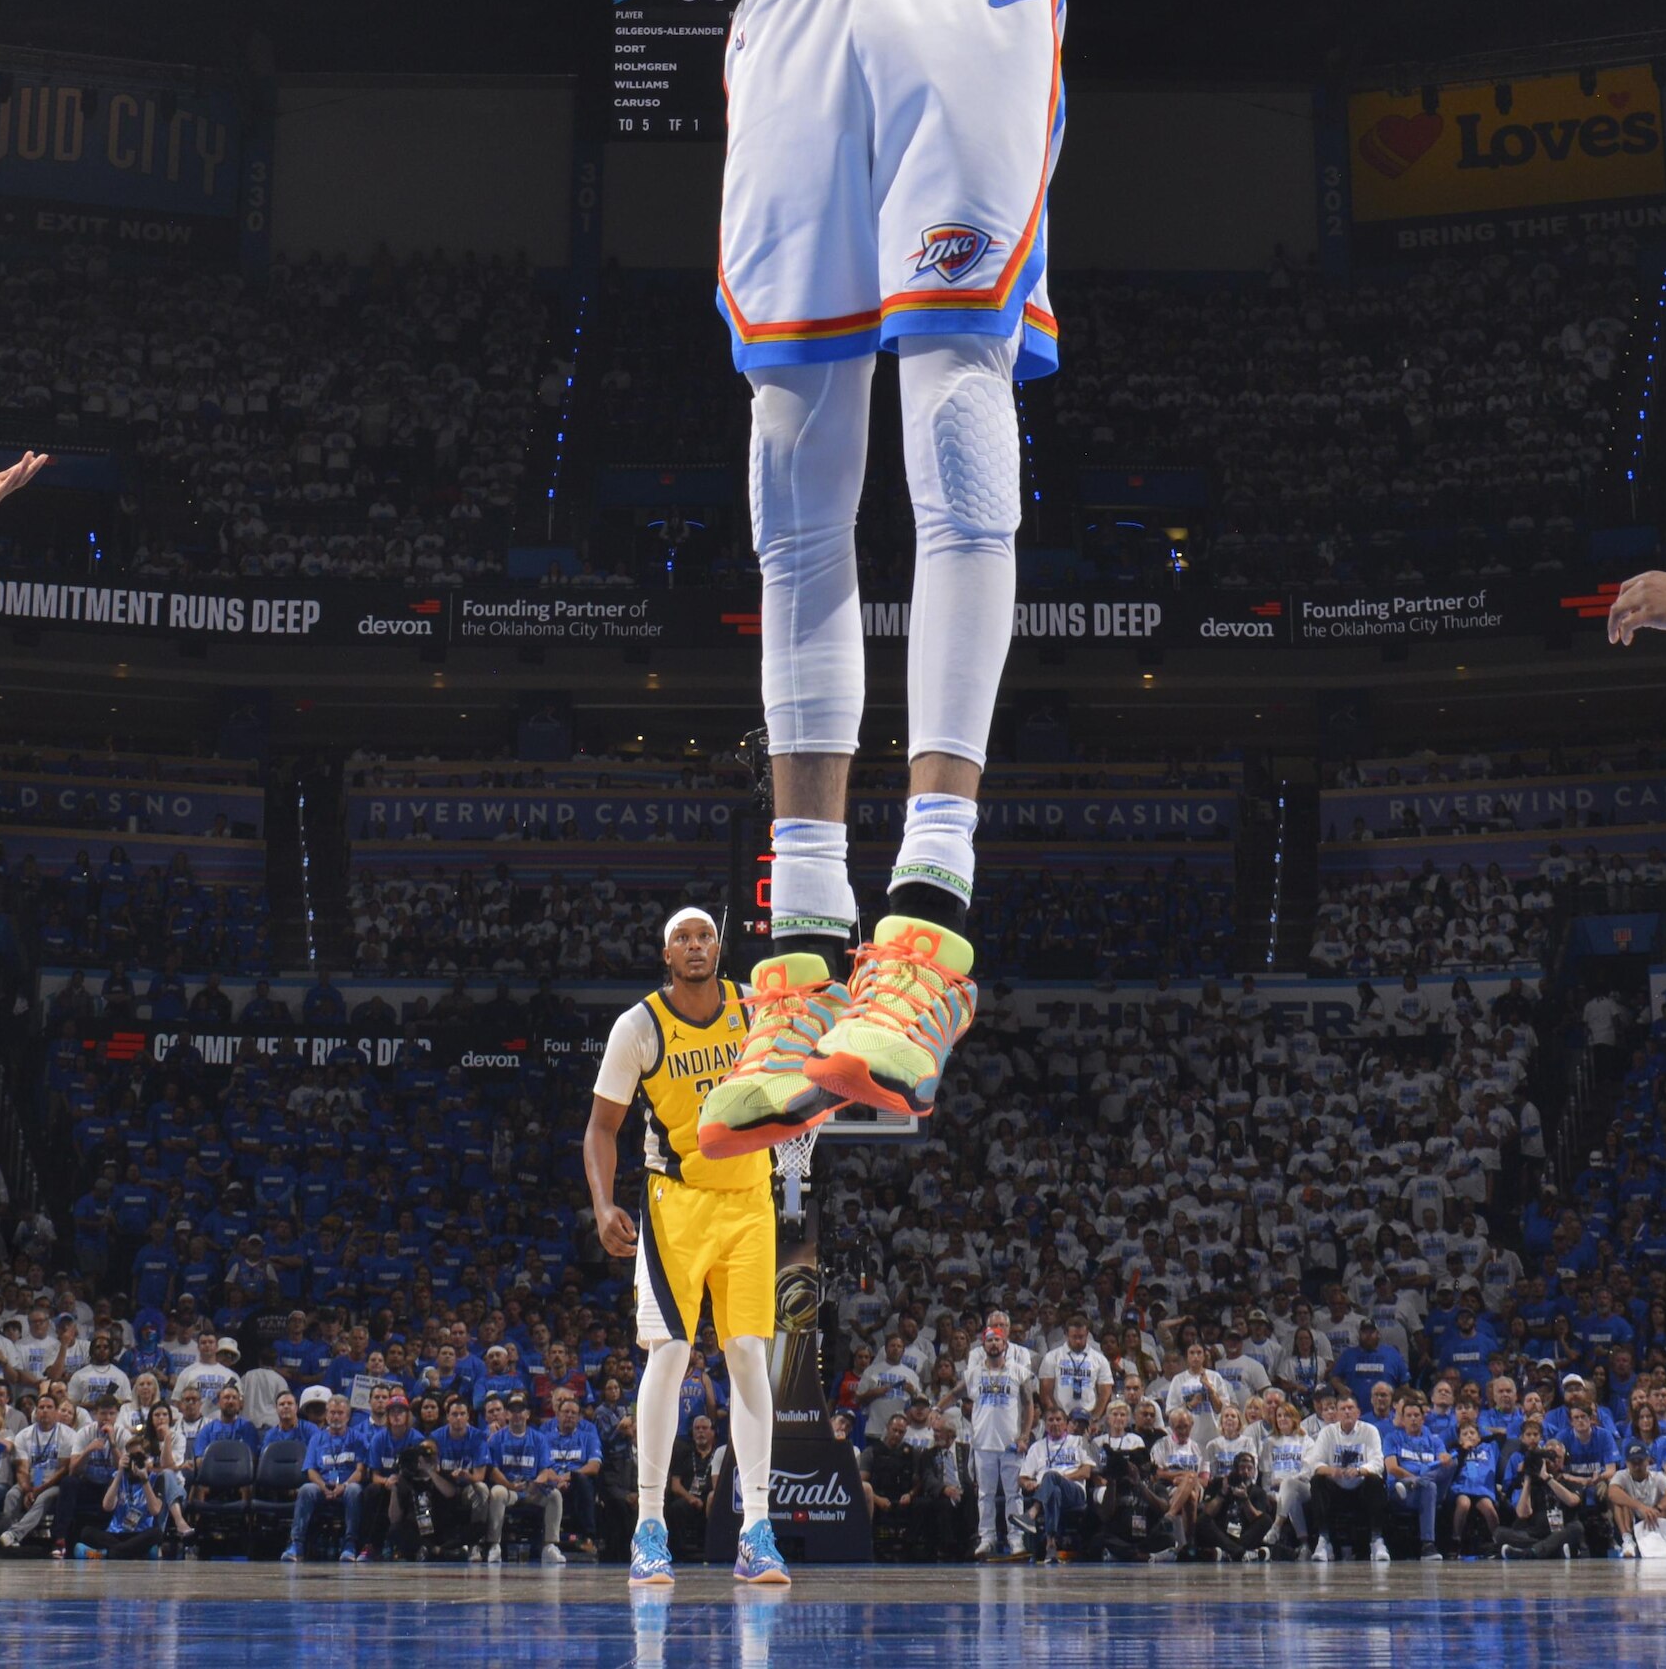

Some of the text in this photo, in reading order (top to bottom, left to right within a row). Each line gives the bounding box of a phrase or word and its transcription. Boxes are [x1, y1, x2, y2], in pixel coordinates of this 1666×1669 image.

[615, 10, 644, 20] PLAYER
[615, 26, 724, 36] GILGEOUS-ALEXANDER
[614, 44, 646, 53] DORT
[614, 62, 677, 72] HOLMGREN
[614, 80, 670, 90] WILLIAMS
[614, 98, 661, 108] CARUSO
[108, 90, 228, 198] CITY
[36, 210, 111, 237] EXIT
[119, 217, 194, 246] NOW
[1397, 222, 1497, 251] BRING
[1506, 212, 1568, 239] THE
[915, 232, 977, 272] OKC
[169, 593, 245, 633] RUNS
[251, 599, 321, 634] DEEP
[462, 599, 625, 621] Founding Partner
[1013, 602, 1162, 638] RUNS DEEP
[1302, 593, 1465, 621] Founding Partner
[357, 615, 432, 635] devon
[489, 621, 663, 639] Oklahoma City Thunder
[1199, 617, 1275, 638] devon
[1331, 611, 1503, 638] Oklahoma City Thunder
[369, 799, 732, 826] RIVERWIND CASINO
[1083, 801, 1220, 827] CASINO
[1389, 779, 1603, 823] RIVERWIND
[460, 1047, 521, 1069] devon
[666, 1040, 741, 1080] INDIAN
[775, 1409, 821, 1423] YouTube TV
[769, 1469, 852, 1506] Finals
